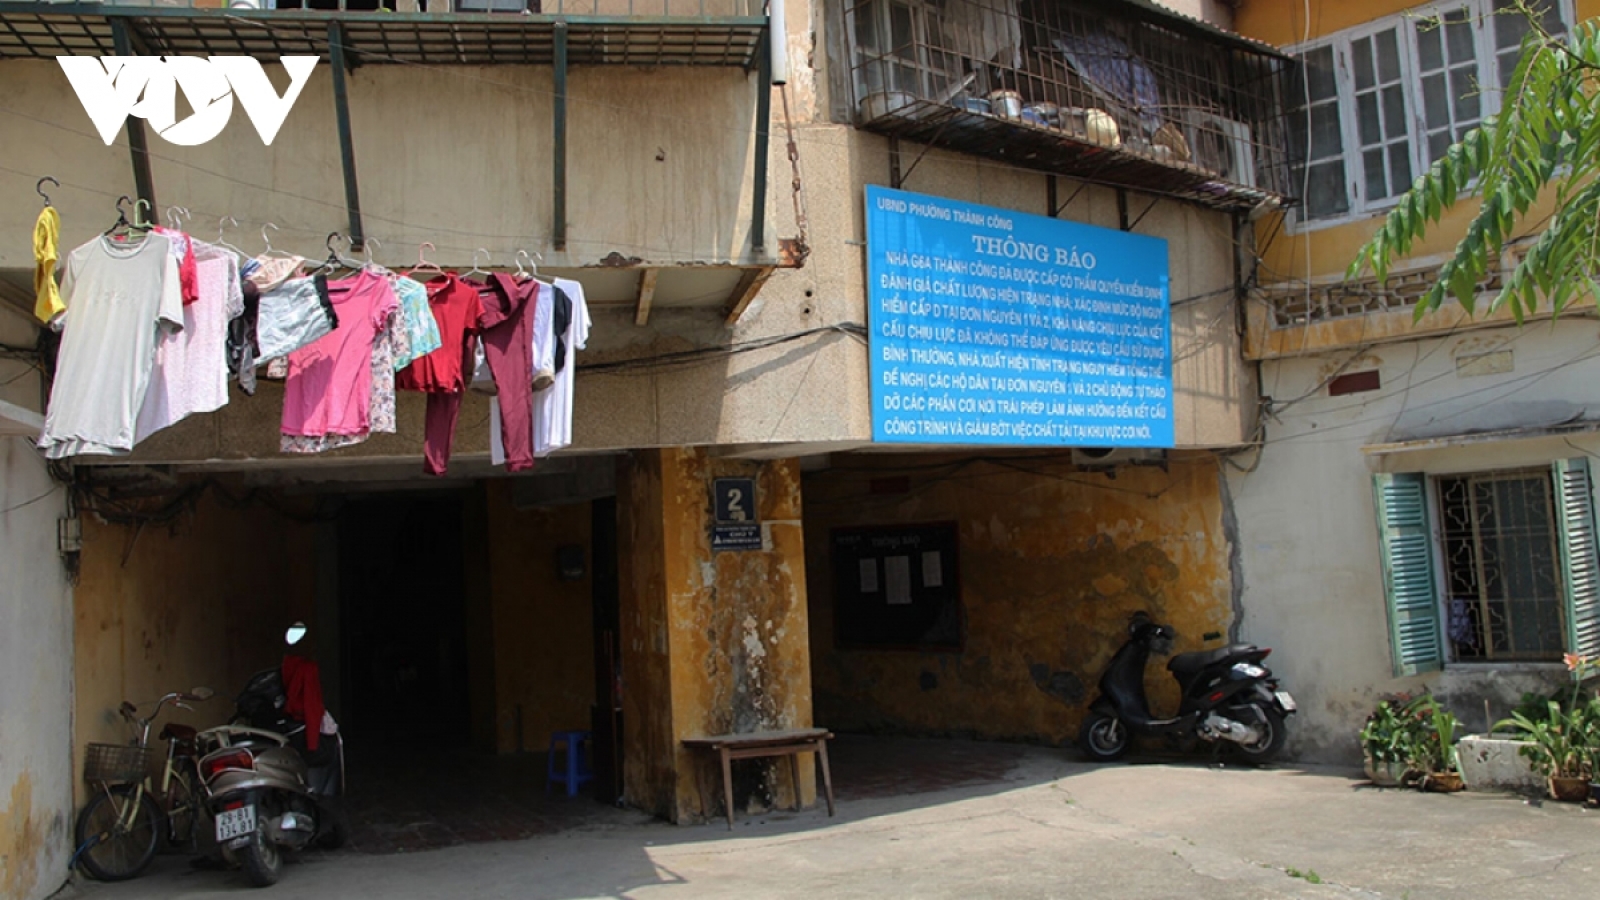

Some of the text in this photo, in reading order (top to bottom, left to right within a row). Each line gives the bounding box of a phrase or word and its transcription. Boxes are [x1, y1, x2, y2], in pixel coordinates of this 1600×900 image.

[877, 197, 1013, 230] UBND PHƯỜNG THÀNH CÔNG
[886, 248, 909, 267] NHÀ
[934, 253, 968, 275] THÀNH
[969, 260, 998, 278] CÔNG
[999, 263, 1012, 280] ĐÃ
[1013, 267, 1039, 285] ĐƯỢC
[1040, 268, 1059, 285] CẤP
[1060, 273, 1073, 289] CÓ
[972, 235, 1097, 270] THÔNG BÁO
[881, 272, 912, 291] ĐÁNH
[912, 275, 932, 293] GIÁ
[933, 277, 961, 297] CHẤT
[962, 283, 997, 302] LƯỢNG
[997, 286, 1019, 305] HIỆN
[1021, 291, 1051, 308] TRẠNG
[1074, 295, 1091, 313] XÁC
[1092, 301, 1112, 316] ĐỊNH
[1129, 303, 1141, 320] ĐỘ
[1142, 306, 1164, 320] NGUY
[910, 297, 932, 317] CẤP
[934, 304, 941, 318] D
[942, 304, 959, 322] TẠI
[960, 306, 981, 321] ĐƠN
[983, 307, 1022, 325] NGUYÊN
[1023, 313, 1028, 326] 1
[1028, 312, 1042, 327] VÀ
[882, 319, 905, 337] CẤU
[908, 324, 933, 343] CHỊU
[935, 326, 956, 344] LỰC
[958, 327, 972, 344] ĐÃ
[974, 329, 1009, 347] KHÔNG
[1030, 335, 1049, 350] ĐÁP
[1071, 339, 1095, 356] ĐƯỢC
[1096, 342, 1112, 356] YÊU
[1143, 347, 1164, 360] DỤNG
[883, 343, 909, 362] BÌNH
[911, 346, 957, 367] THƯỜNG,
[959, 350, 981, 367] NHÀ
[981, 350, 1006, 368] XUẤT
[1008, 354, 1029, 373] HIỆN
[1031, 355, 1050, 371] TÌNH
[1052, 358, 1081, 376] TRẠNG
[1083, 362, 1105, 376] NGUY
[900, 372, 928, 390] NGHỊ
[928, 371, 951, 389] CÁC
[952, 372, 967, 392] HỘ
[968, 373, 989, 390] DÂN
[991, 377, 1006, 394] TẠI
[1007, 378, 1028, 393] ĐƠN
[1029, 379, 1066, 395] NGUYÊN
[1073, 379, 1085, 396] VÀ
[1087, 384, 1092, 396] 2
[1092, 381, 1109, 397] CHỦ
[1110, 381, 1133, 399] ĐỘNG
[902, 392, 926, 411] CÁC
[997, 397, 1018, 414] TRÁI
[1021, 399, 1045, 415] PHÉP
[1047, 399, 1065, 415] LÀM
[1087, 399, 1116, 418] HƯỞNG
[1116, 401, 1133, 418] ĐẾN
[1134, 402, 1149, 419] KẾT
[1150, 403, 1166, 419] CẤU
[884, 417, 917, 435] CÔNG
[918, 417, 950, 436] TRÌNH
[950, 417, 964, 435] VÀ
[964, 418, 990, 436] GIẢM
[990, 419, 1011, 437] BỚT
[1011, 420, 1032, 440] VIỆC
[1033, 420, 1057, 437] CHẤT
[1058, 421, 1073, 437] TẢI
[1073, 425, 1087, 441] TẠI
[1087, 426, 1104, 438] KHU
[1104, 425, 1122, 441] VỰC
[727, 488, 742, 512] 2
